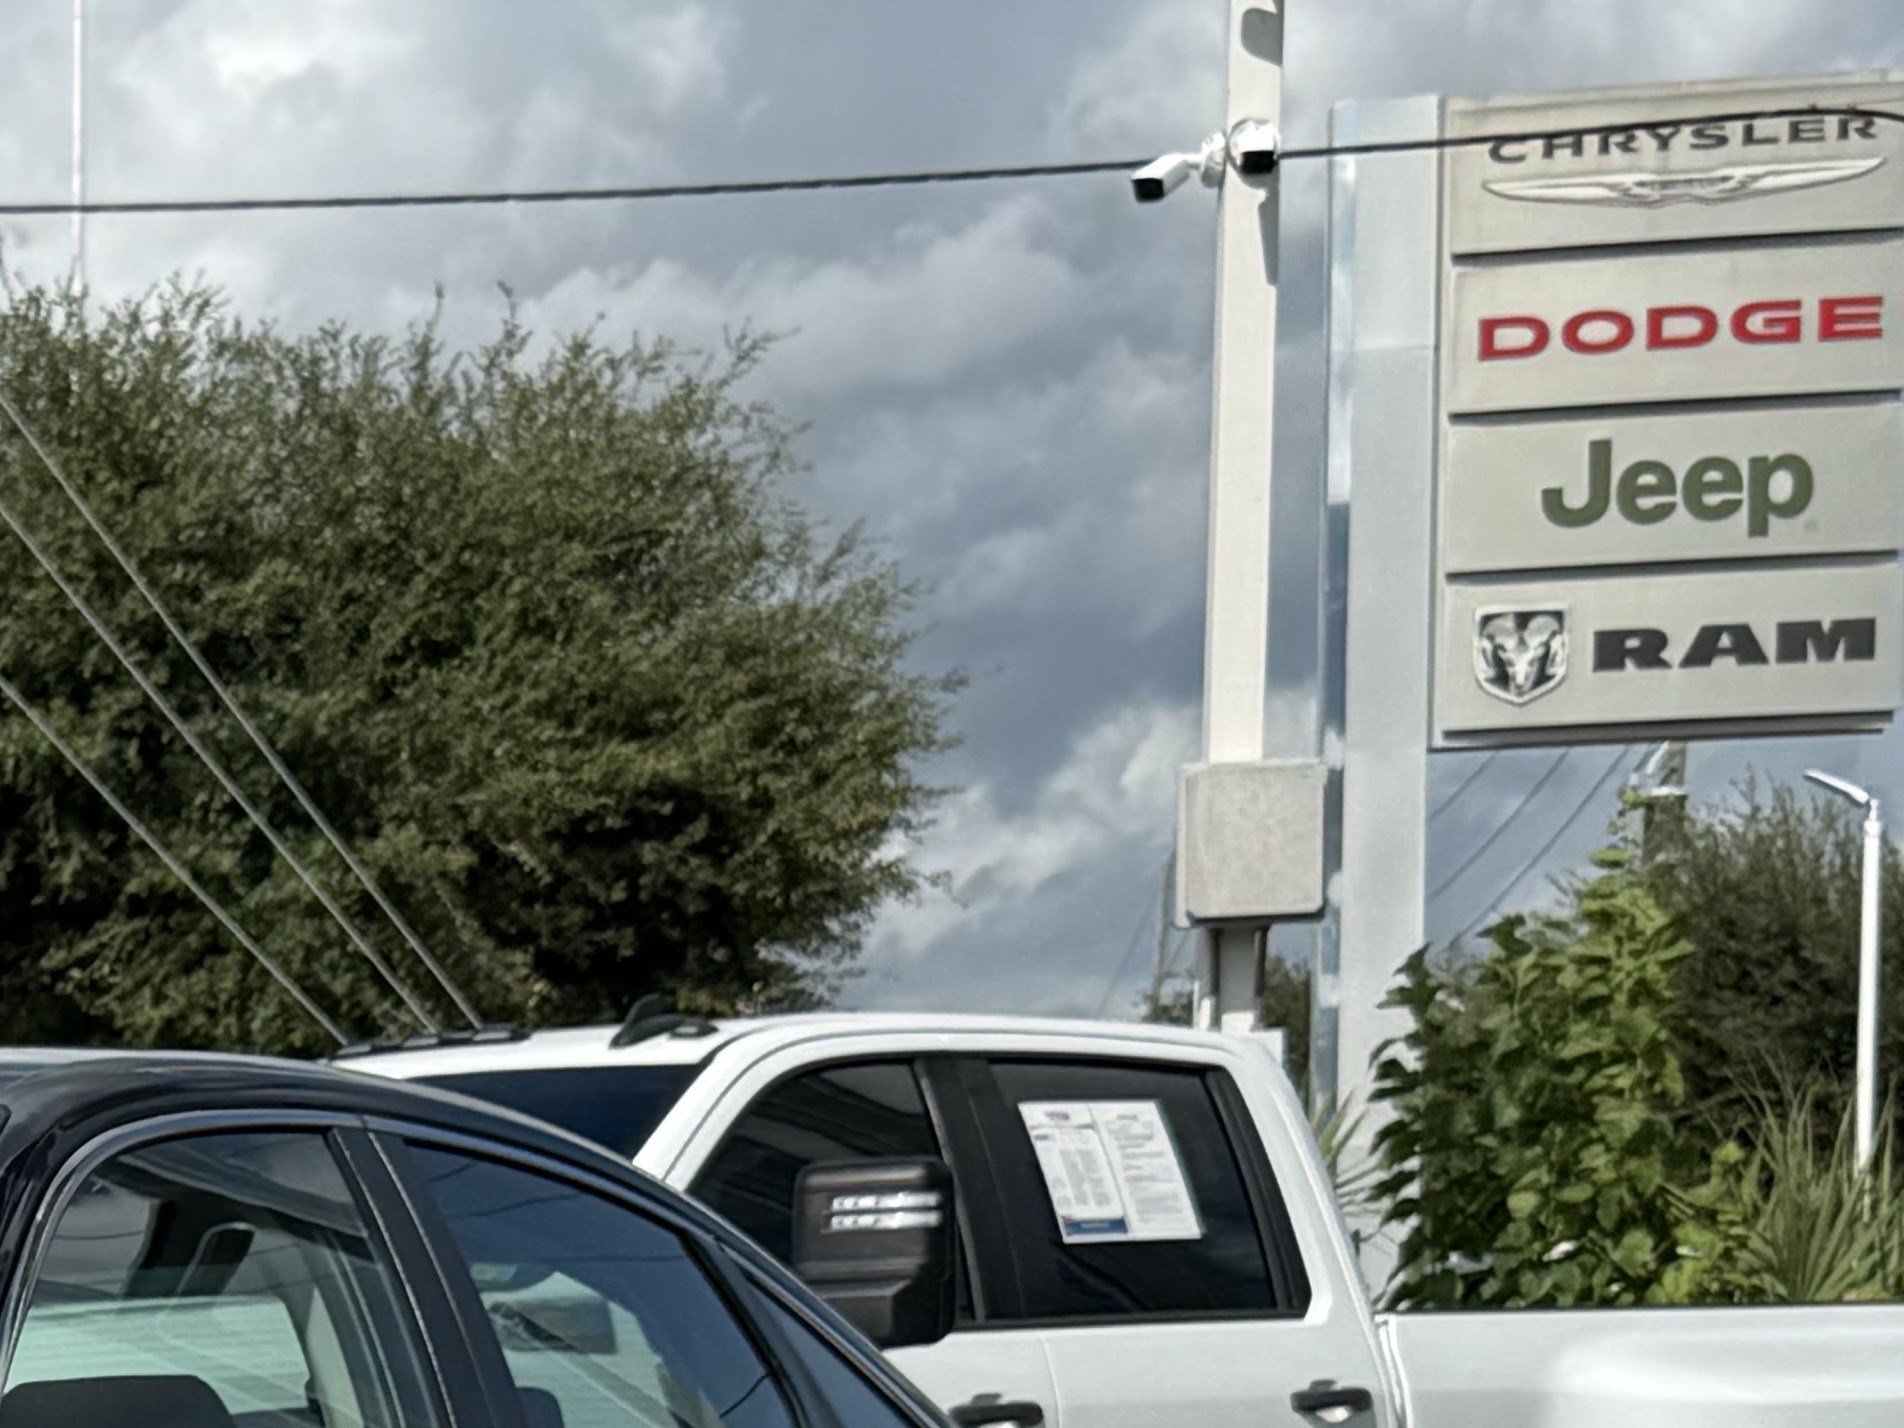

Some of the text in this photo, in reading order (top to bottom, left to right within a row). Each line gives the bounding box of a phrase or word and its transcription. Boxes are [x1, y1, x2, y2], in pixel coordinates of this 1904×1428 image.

[1488, 117, 1878, 164] CHRYSLER
[1477, 295, 1883, 361] DODGE
[1540, 439, 1814, 537] Jeep
[1591, 617, 1877, 673] RAM
